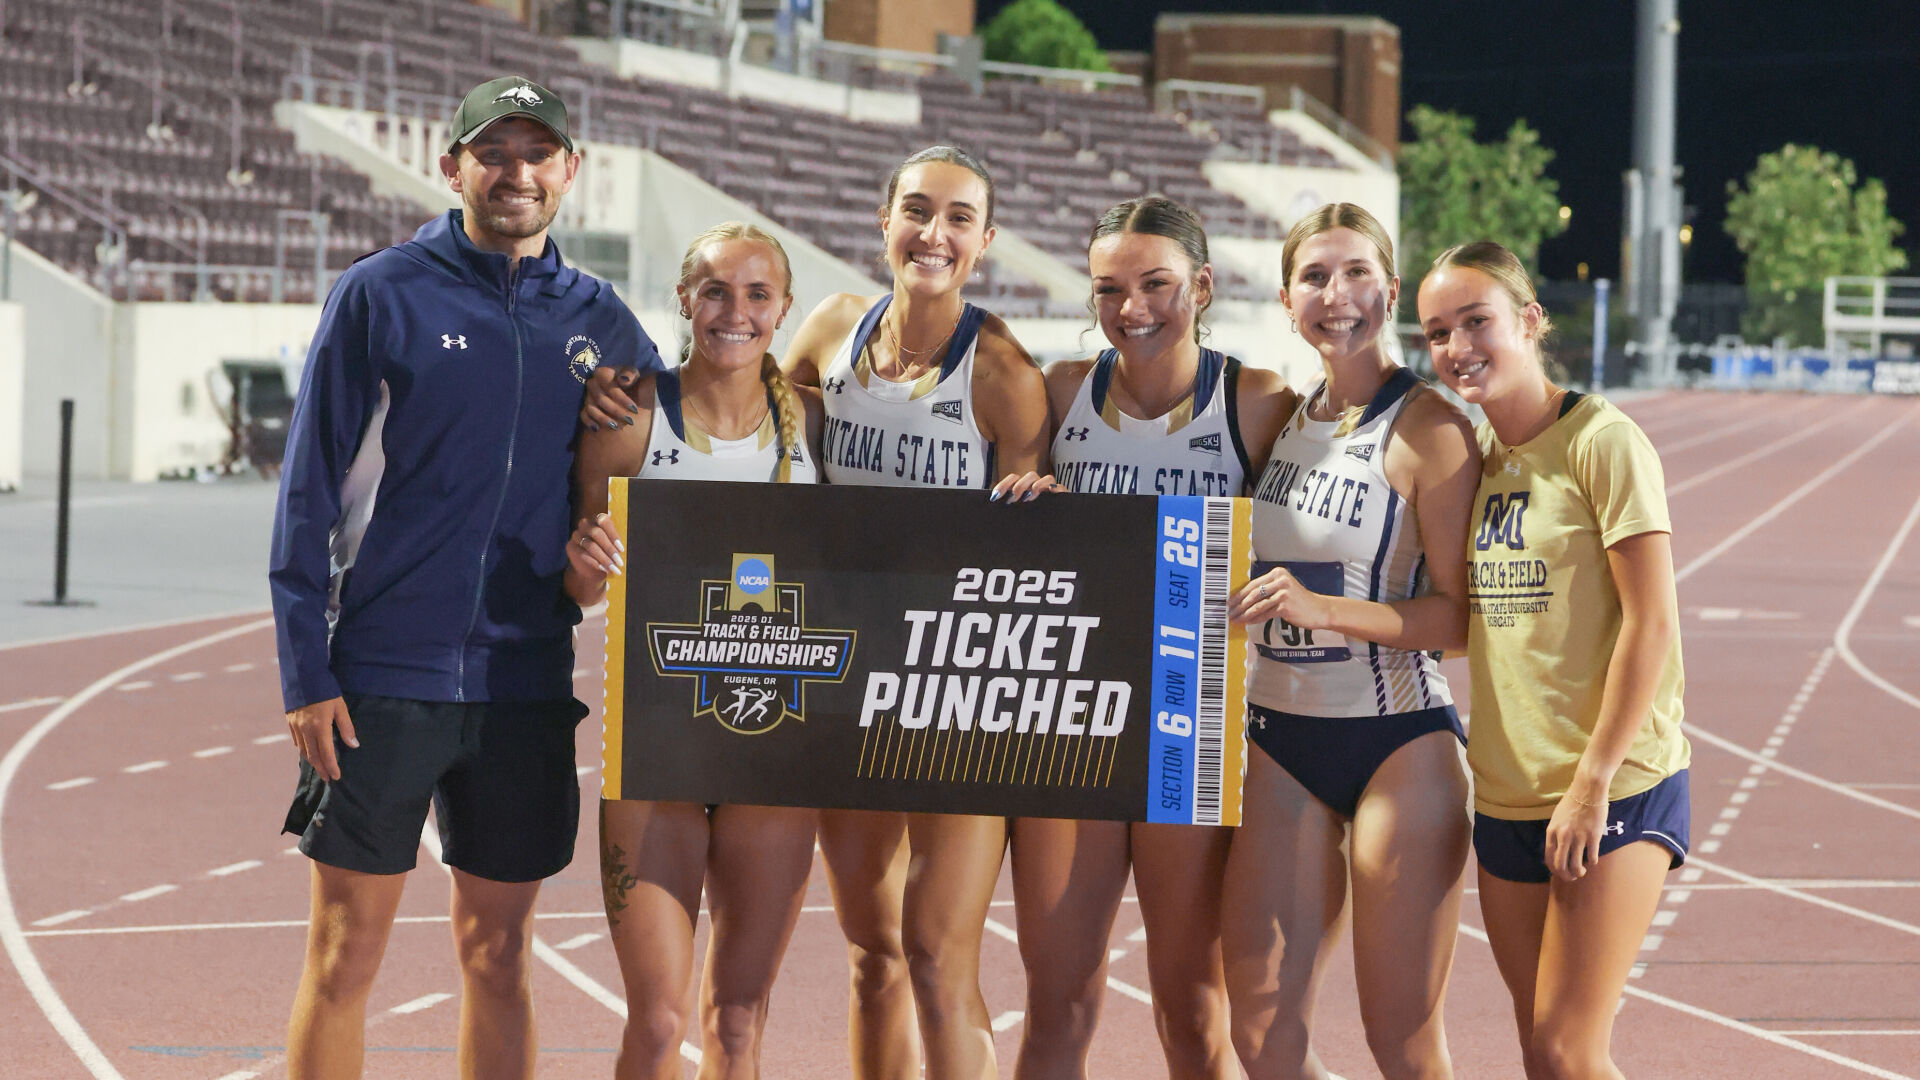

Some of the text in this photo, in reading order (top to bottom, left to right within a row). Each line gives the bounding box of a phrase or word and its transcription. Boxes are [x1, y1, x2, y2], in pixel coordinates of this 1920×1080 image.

[565, 335, 602, 358] MONTANA STATE
[895, 433, 969, 486] STATE
[1297, 469, 1369, 528] STATE
[1476, 491, 1530, 551] M
[739, 575, 769, 586] NCAA
[952, 567, 1077, 605] 2025
[1498, 561, 1506, 589] &
[1508, 560, 1547, 588] FIELD
[730, 615, 773, 624] 2025 DI
[1487, 603, 1507, 615] STATE
[1507, 601, 1549, 614] UNIVERSITY
[703, 623, 800, 641] TRACK & FIELD
[903, 609, 1100, 672] TICKET
[665, 639, 838, 667] CHAMPIONSHIPS
[1157, 515, 1199, 811] SECTION 6 ROW 11 SEAT 25
[723, 676, 776, 686] EUGENE, OR
[858, 671, 1132, 737] PUNCHED
